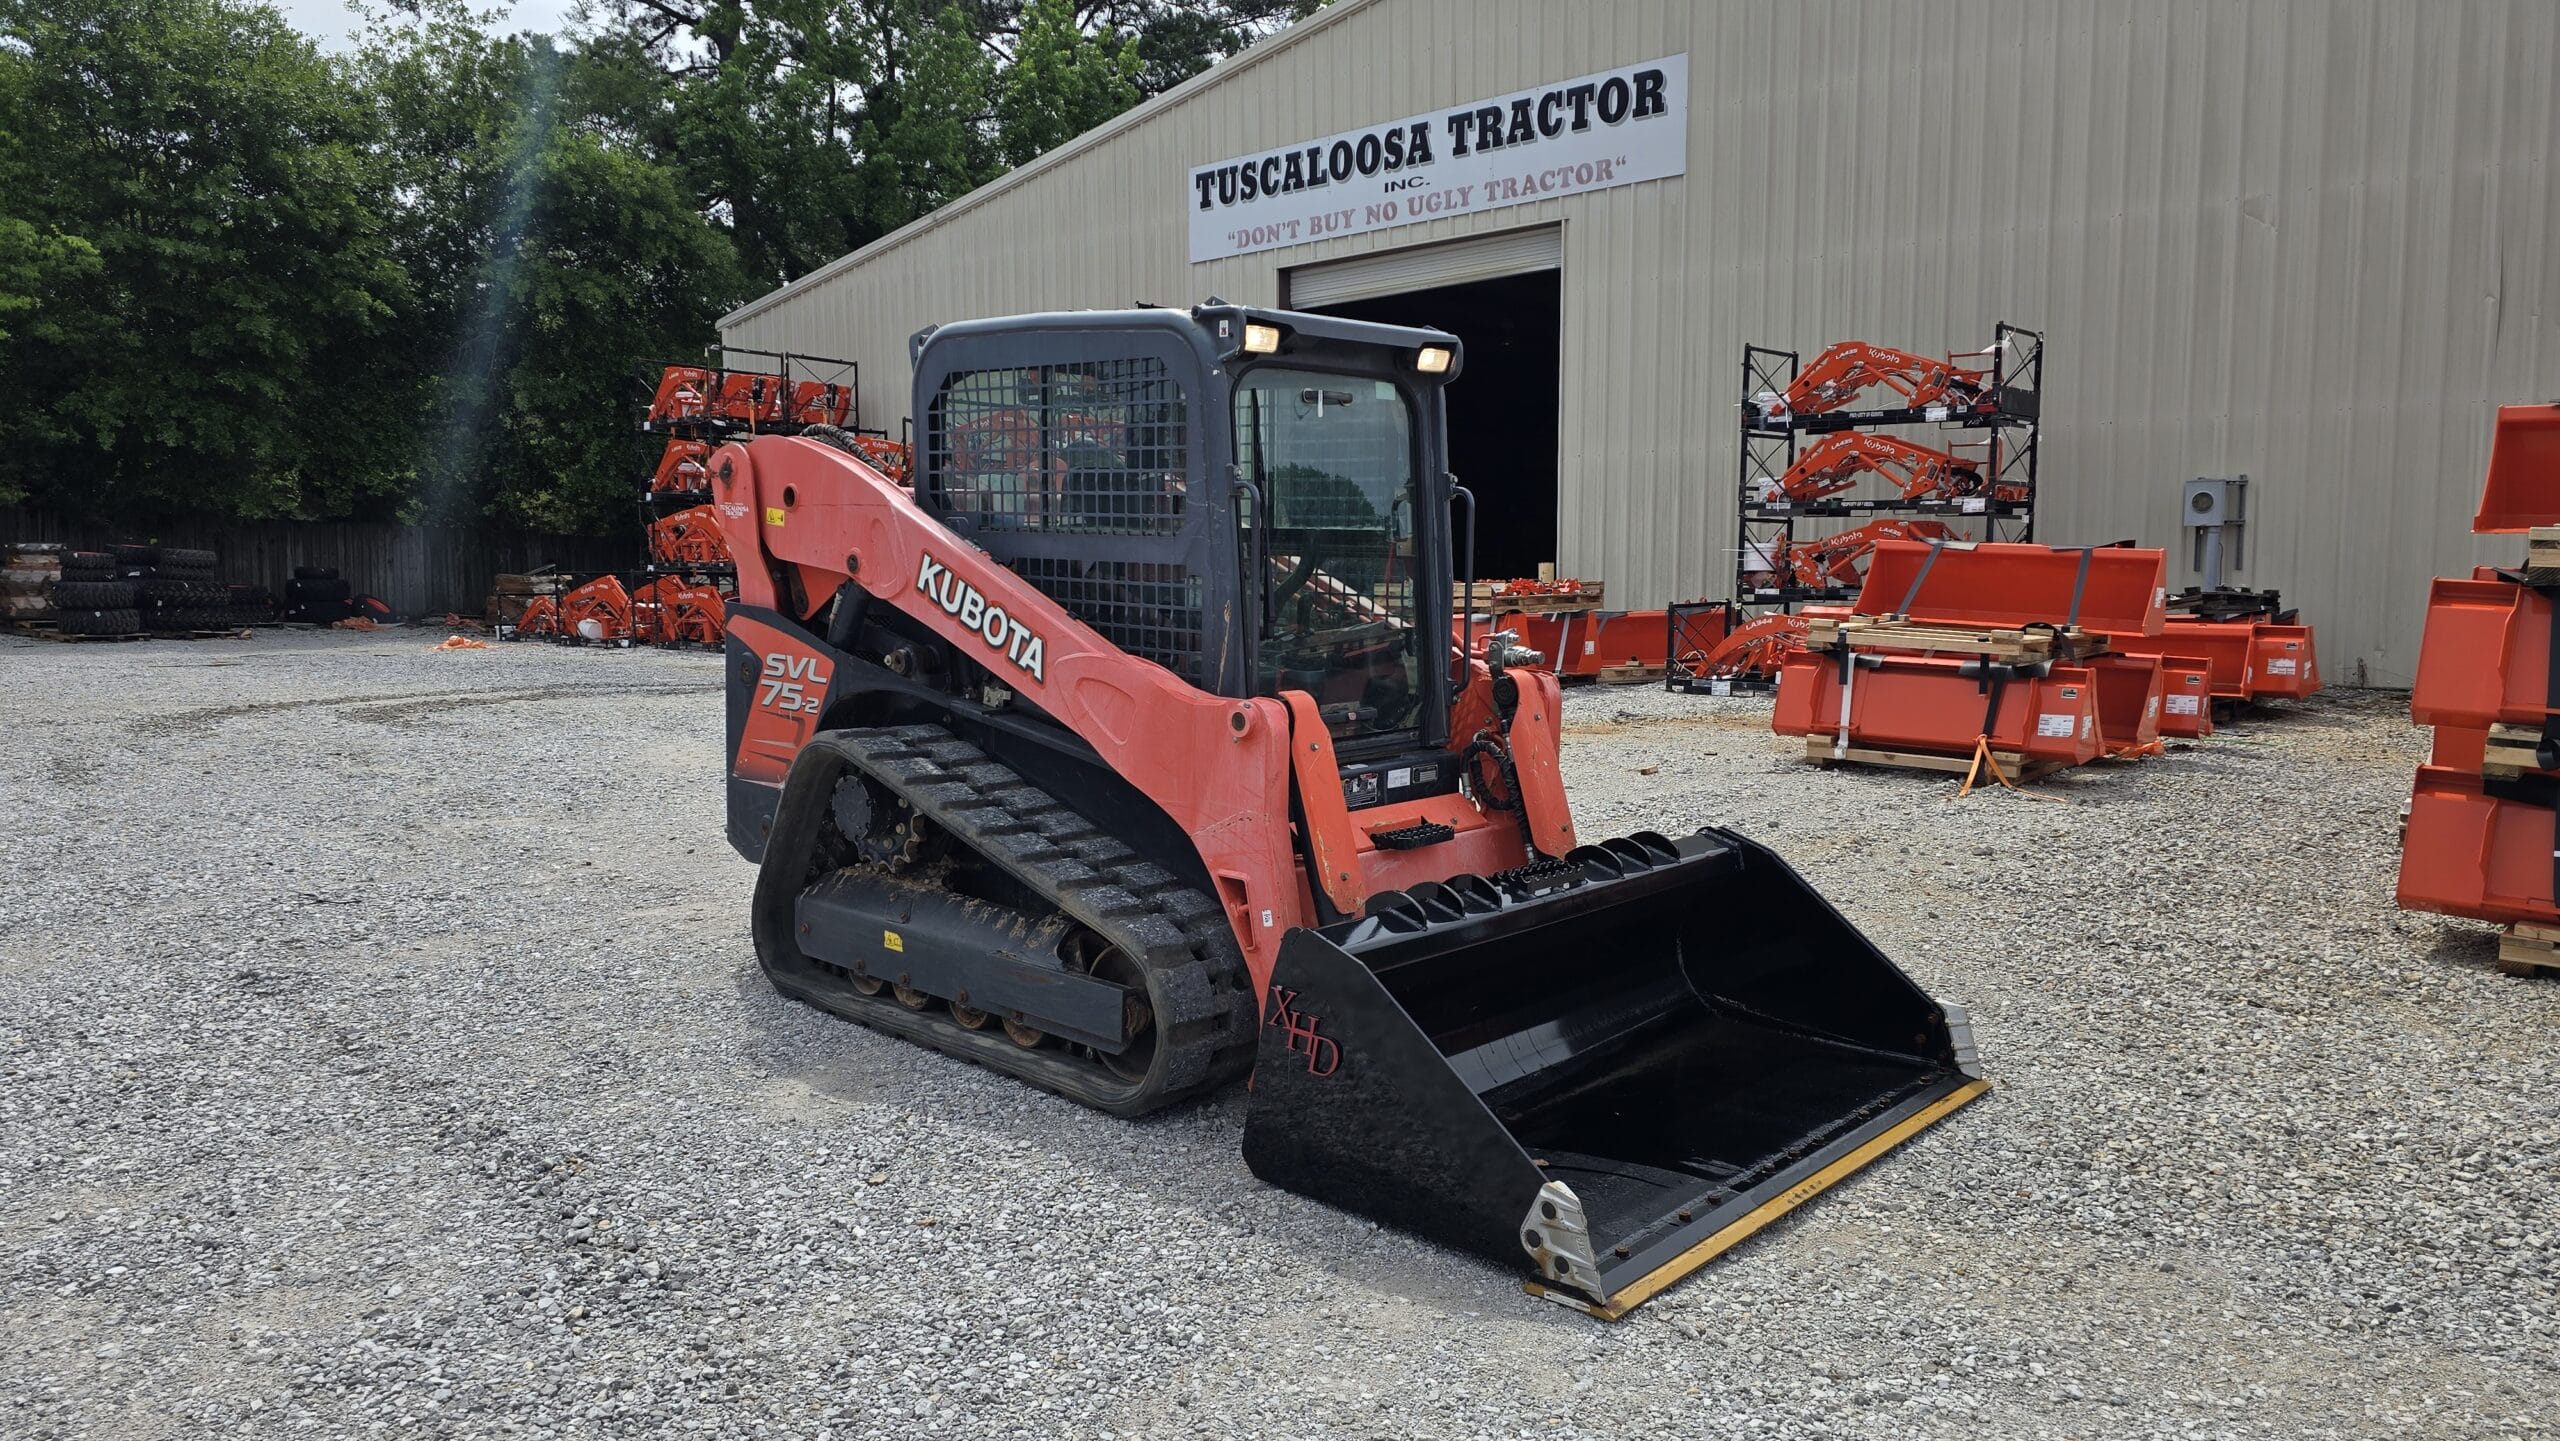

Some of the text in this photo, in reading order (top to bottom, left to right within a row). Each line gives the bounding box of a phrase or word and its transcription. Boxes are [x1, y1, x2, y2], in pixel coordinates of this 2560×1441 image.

[1196, 69, 1667, 211] TUSCALOOSA TRACTOR
[1384, 176, 1431, 193] INC.
[1310, 208, 1356, 236] BUY
[1365, 200, 1398, 226] NO
[1407, 185, 1474, 216] UGLY
[1868, 348, 1900, 363] Kubota
[1864, 438, 1896, 454] Kubota
[1830, 531, 1863, 546] Kubota
[916, 553, 1043, 682] KUBOTA
[764, 652, 828, 684] SVL
[1267, 985, 1339, 1077] XHD
